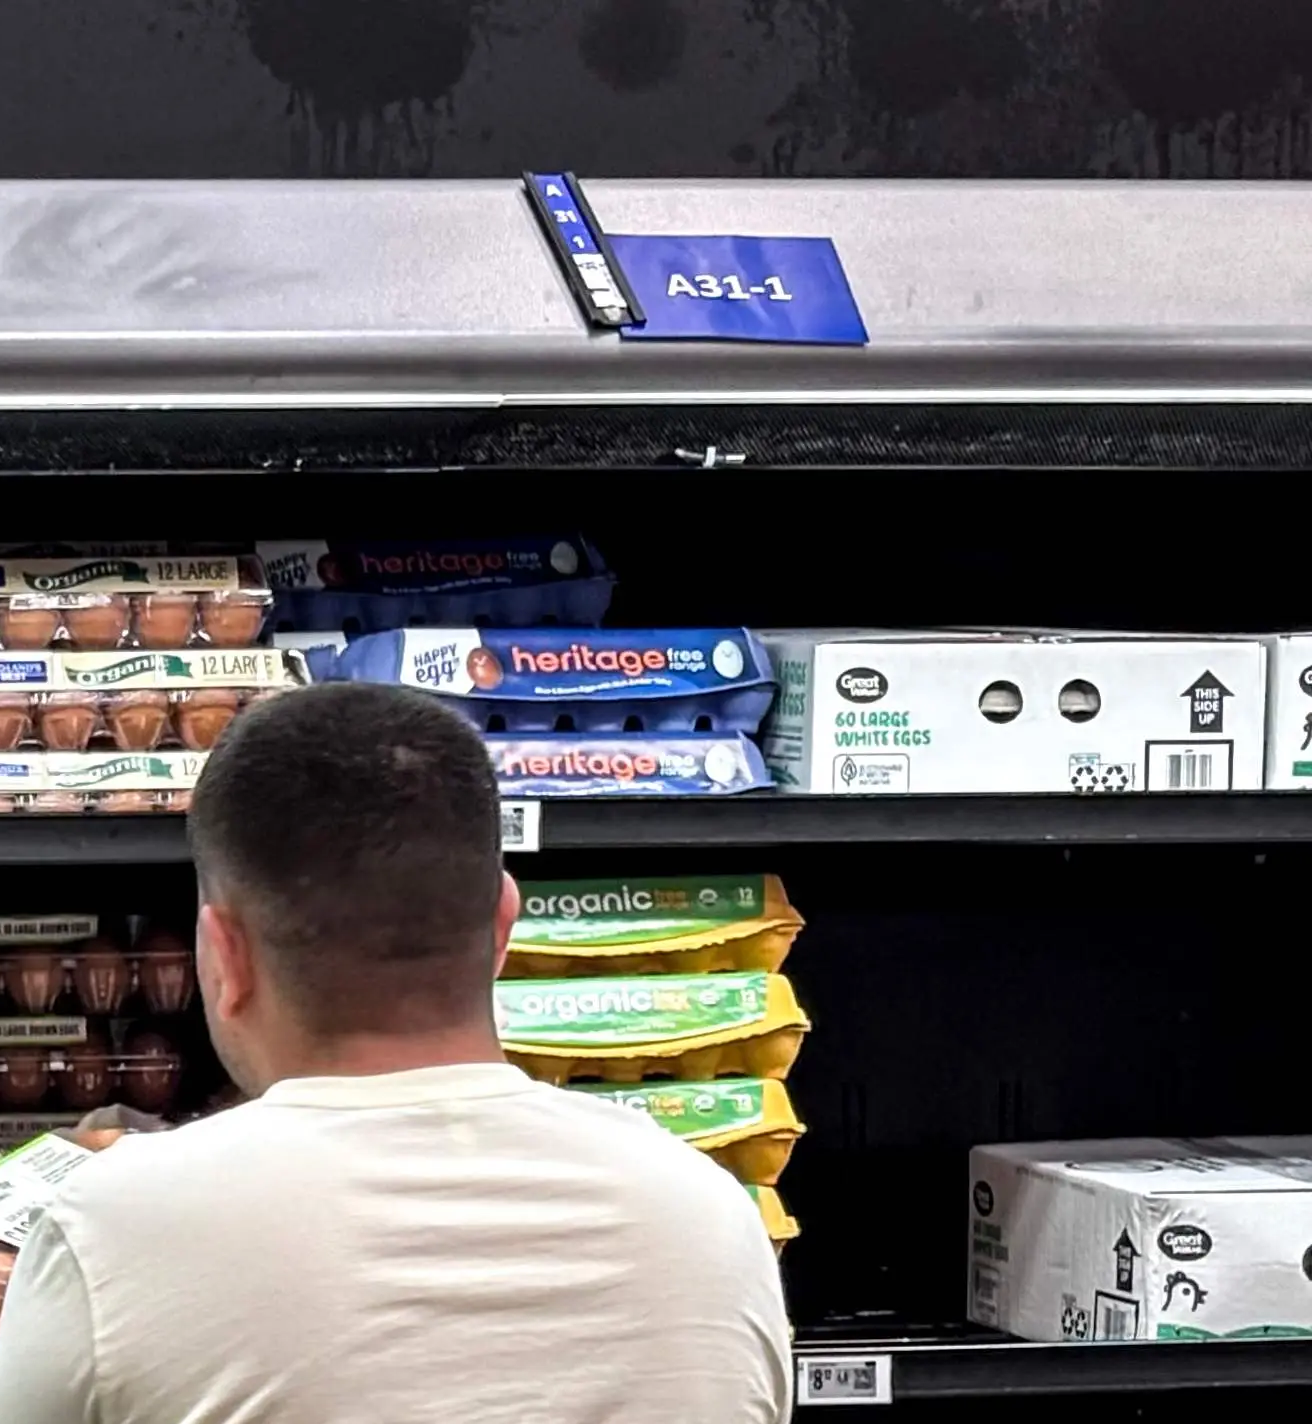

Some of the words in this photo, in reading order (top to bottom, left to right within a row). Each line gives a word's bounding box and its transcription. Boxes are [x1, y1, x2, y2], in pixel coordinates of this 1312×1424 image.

[546, 184, 561, 197] A
[554, 210, 577, 223] 31
[573, 236, 584, 248] 1
[668, 274, 792, 300] A31-1
[360, 552, 502, 574] heritage
[33, 562, 122, 590] Organic
[158, 562, 174, 580] 12
[178, 562, 227, 580] LARGE
[413, 644, 457, 669] HAPPY
[512, 645, 664, 677] heritage
[667, 648, 703, 660] free
[415, 658, 458, 686] egg
[841, 675, 879, 689] Great
[1195, 688, 1219, 699] THIS
[1194, 701, 1219, 712] SIDE
[835, 712, 856, 727] 60
[861, 711, 909, 727] LARGE
[1199, 714, 1215, 724] UP
[835, 731, 888, 746] WHITE
[894, 730, 931, 746] EGGS
[503, 749, 656, 781] heritage
[526, 885, 652, 919] organic
[738, 888, 753, 900] 12
[522, 987, 653, 1019] organic
[1163, 1232, 1203, 1246] Great
